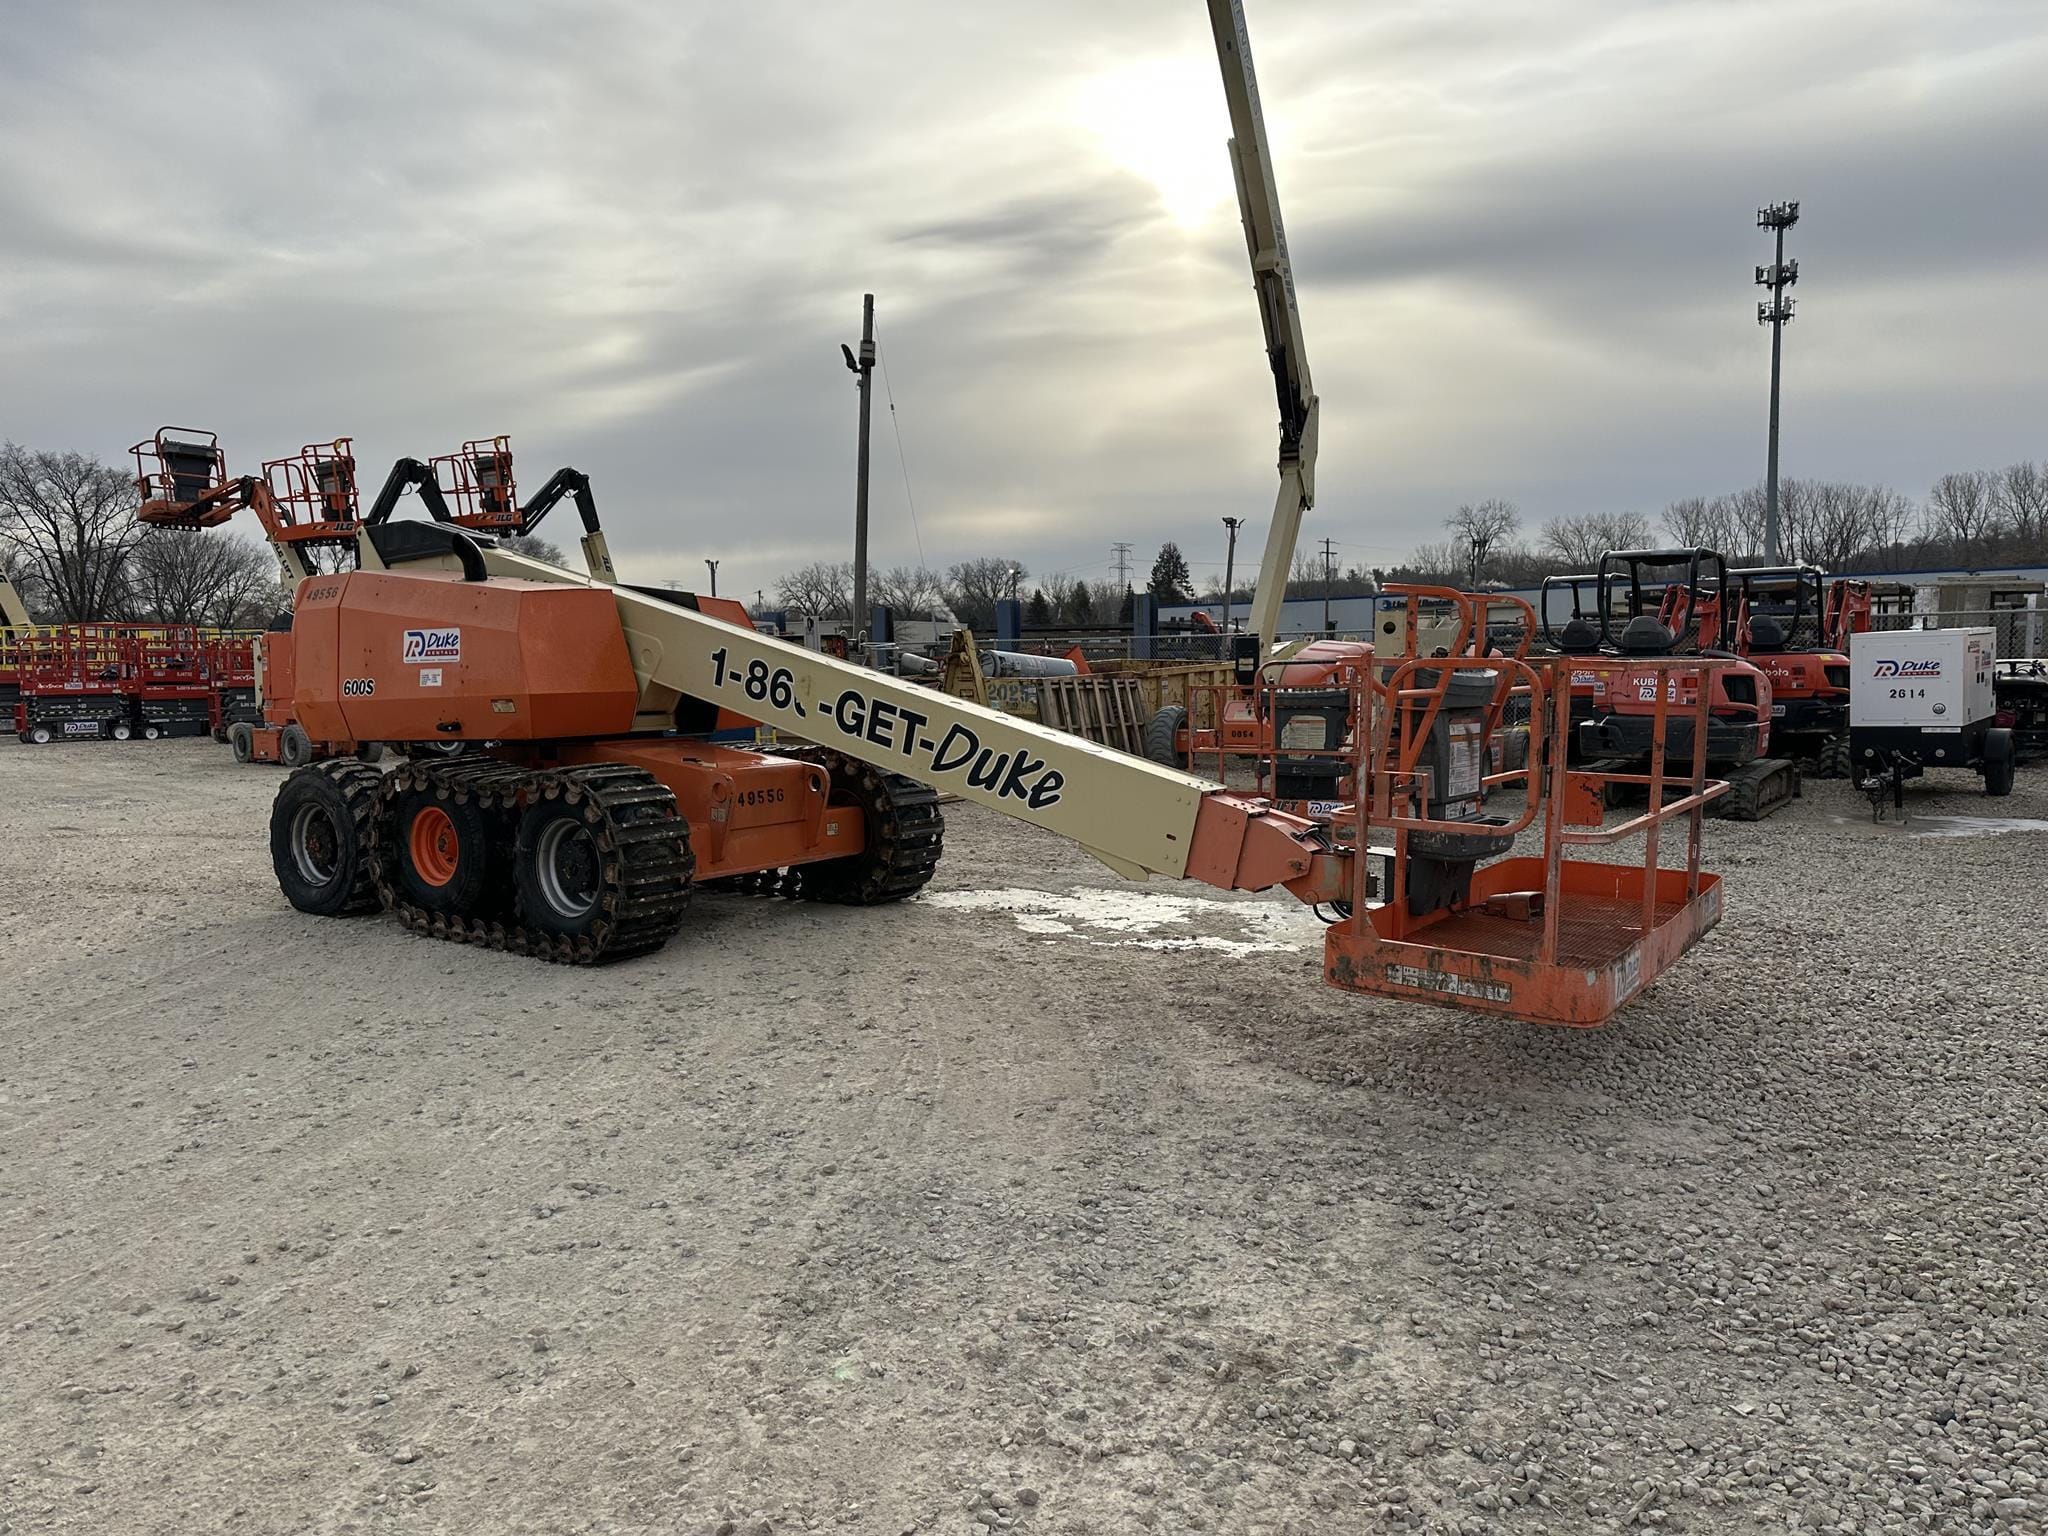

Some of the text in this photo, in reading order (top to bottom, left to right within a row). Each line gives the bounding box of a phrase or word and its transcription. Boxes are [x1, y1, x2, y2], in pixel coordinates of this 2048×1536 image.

[1233, 0, 1260, 117] ENTALS
[1274, 221, 1297, 313] JLG LIFT
[496, 514, 512, 522] JLG
[333, 522, 354, 532] JLG
[282, 560, 295, 579] LIFT
[306, 586, 339, 602] 49556
[427, 632, 459, 649] Duke
[1901, 660, 1941, 671] Duke
[343, 679, 375, 696] 600S
[1632, 677, 1677, 687] KUBA
[1889, 688, 1926, 699] 2614
[737, 788, 785, 807] 49556
[1276, 800, 1299, 811] IFT
